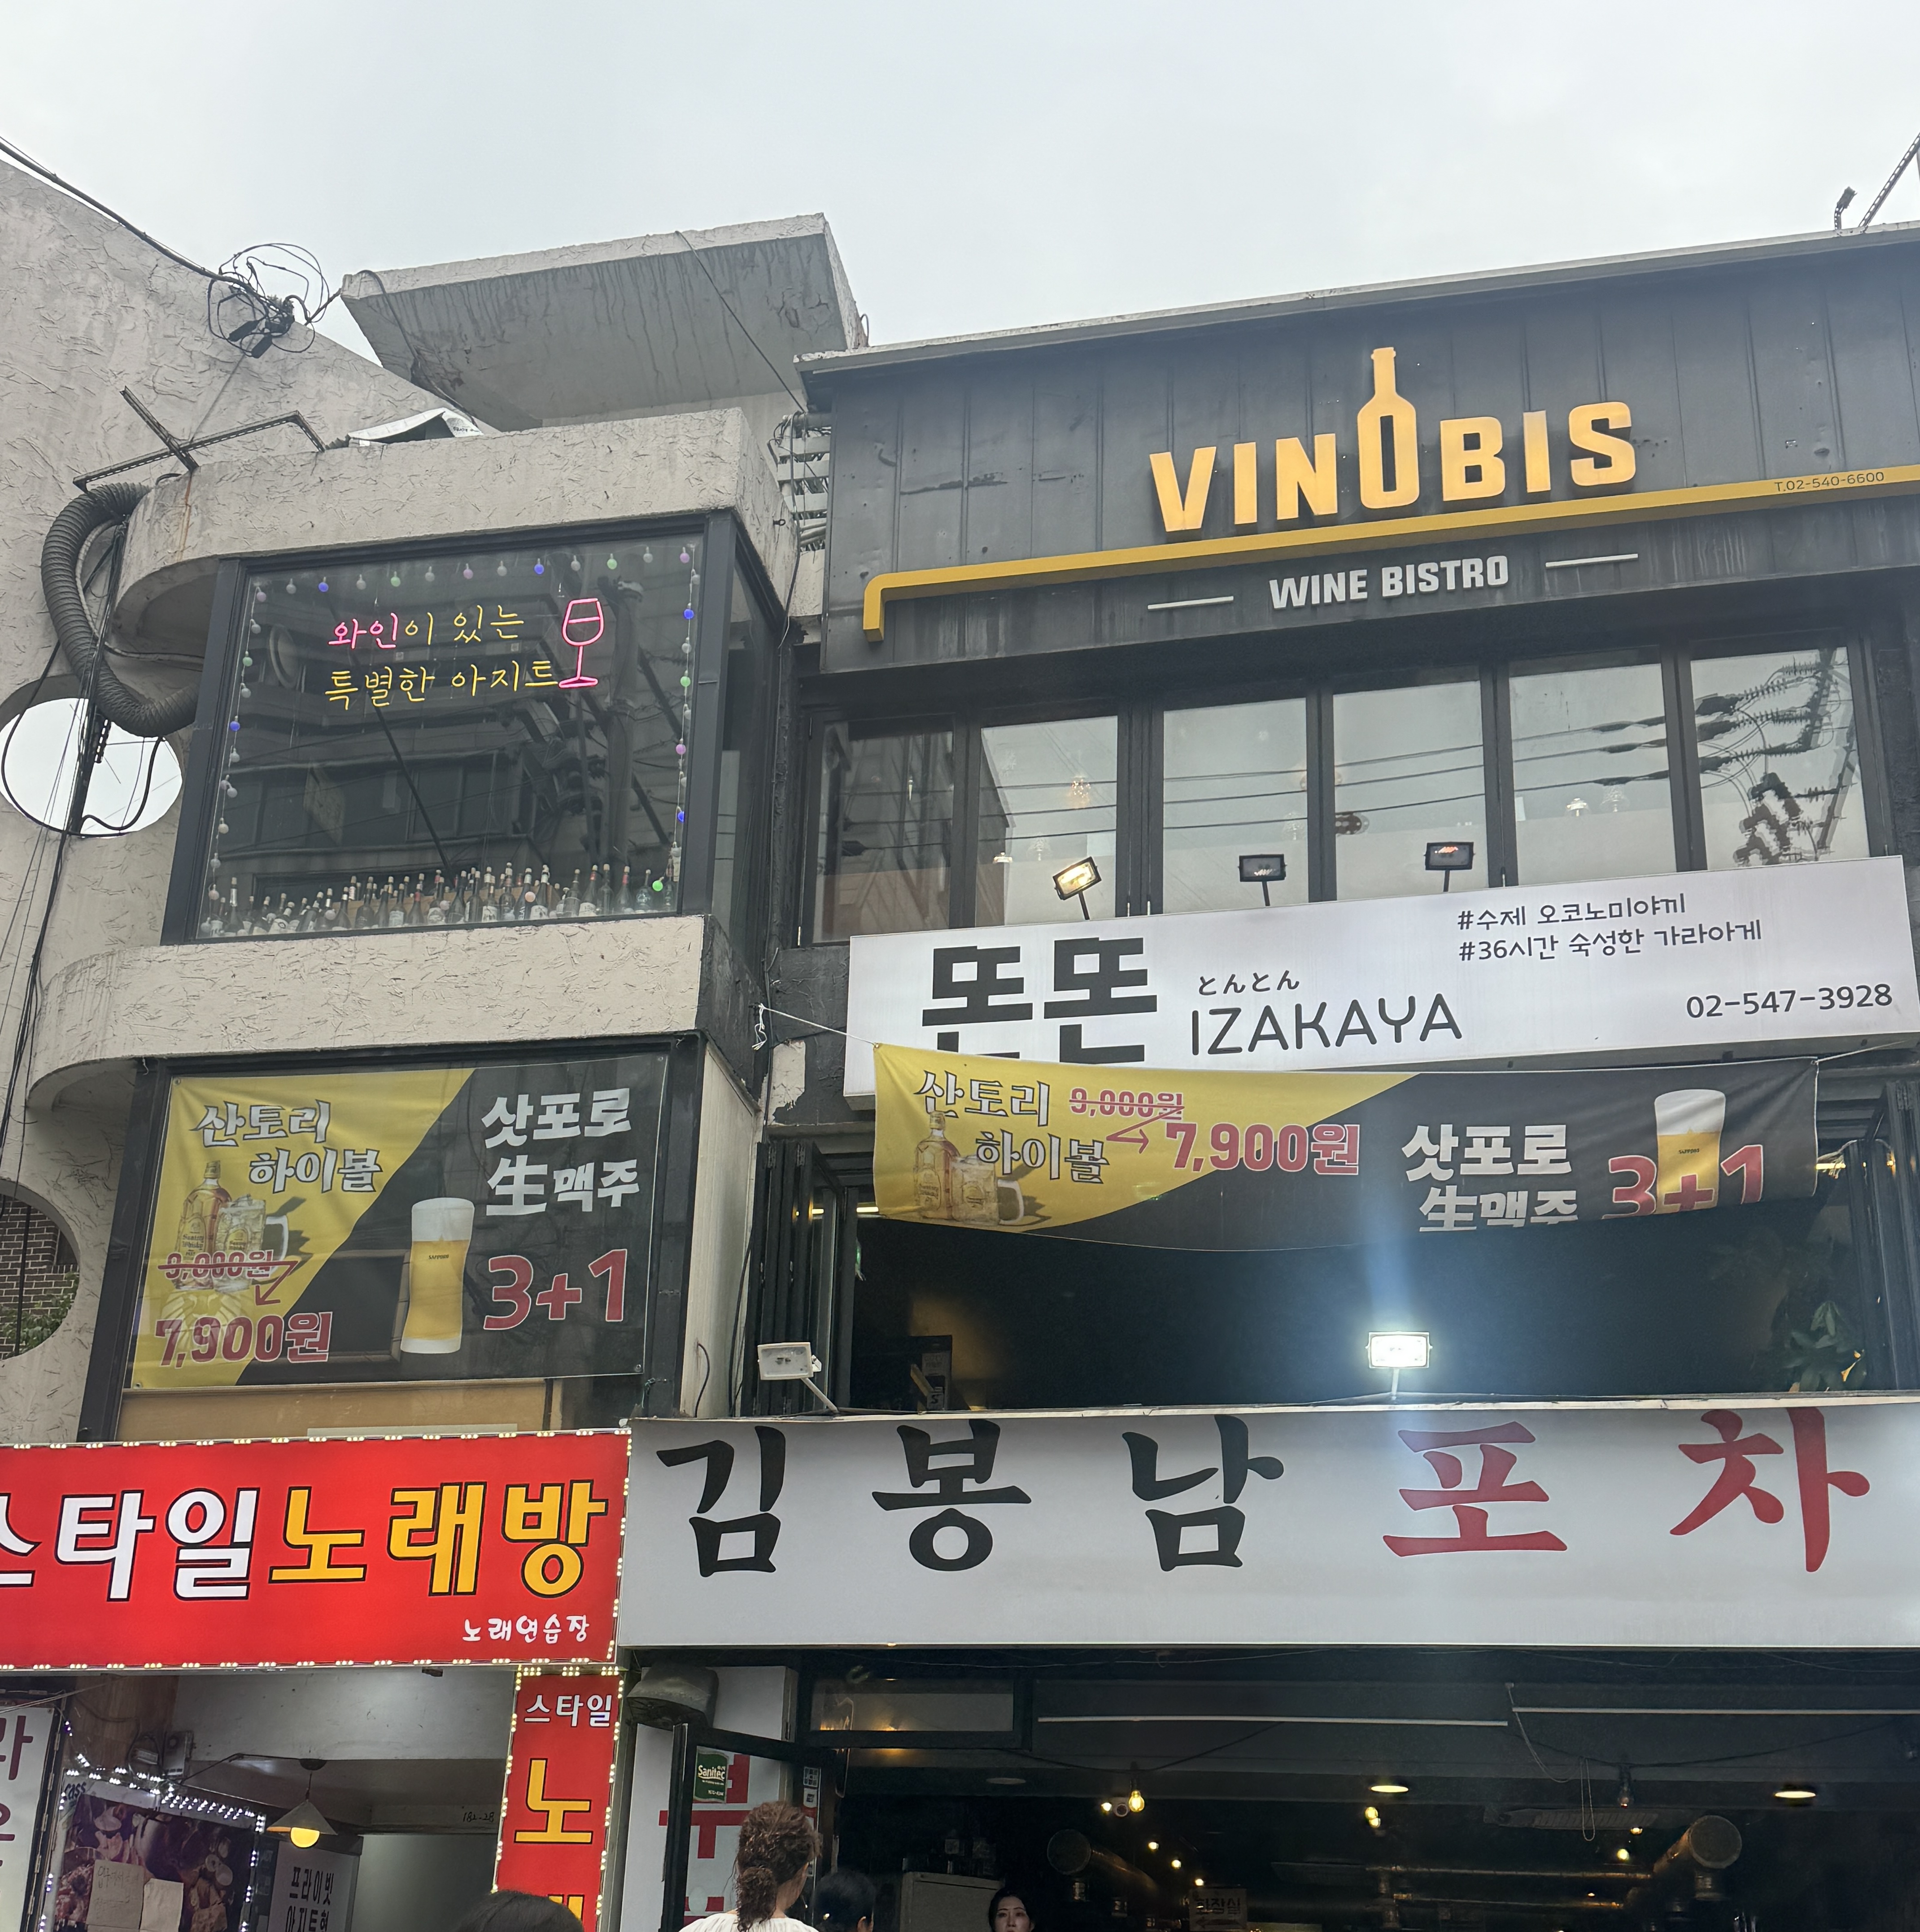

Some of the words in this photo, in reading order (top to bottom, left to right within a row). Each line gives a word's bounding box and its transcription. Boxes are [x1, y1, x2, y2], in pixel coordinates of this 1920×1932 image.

[1148, 347, 1637, 532] VINOBIS
[1775, 471, 1884, 492] T.02-540-6600
[1269, 570, 1368, 609] WINE
[1381, 555, 1509, 598] BISTRO
[328, 612, 434, 650] 와인이
[453, 605, 524, 644] 있는
[325, 666, 434, 710] 특별한
[451, 660, 558, 697] 아지트
[1457, 905, 1526, 930] #수제
[1538, 893, 1686, 925] 오코노미야끼
[1459, 935, 1558, 961] #36시간
[1569, 929, 1644, 957] 숙성한
[1654, 920, 1762, 947] 가라아게
[1198, 969, 1300, 996] とんとん
[1686, 984, 1893, 1018] 02-547-3928
[1192, 993, 1462, 1056] IZAKAYA
[190, 1099, 331, 1148] 산토리
[481, 1087, 632, 1150] 삿포로
[913, 1070, 1050, 1127] 산토리
[1069, 1087, 1183, 1121] 9,000원
[249, 1147, 384, 1195] 하이볼
[976, 1129, 1110, 1184] 하이볼
[1166, 1122, 1360, 1175] 7,900원
[1402, 1124, 1572, 1182] 삿포로
[486, 1155, 640, 1217] 生맥주
[1601, 1144, 1764, 1220] 3+1
[1419, 1185, 1579, 1232] 生맥주
[484, 1249, 628, 1331] 3+1
[154, 1312, 334, 1369] 7,900원
[655, 1414, 1284, 1578] 김봉남
[1383, 1406, 1870, 1573] 포차
[462, 1614, 590, 1644] 노래연습장
[524, 1694, 612, 1727] 스타일
[698, 1765, 725, 1779] Sanitec
[290, 1867, 334, 1906] 프라이빗
